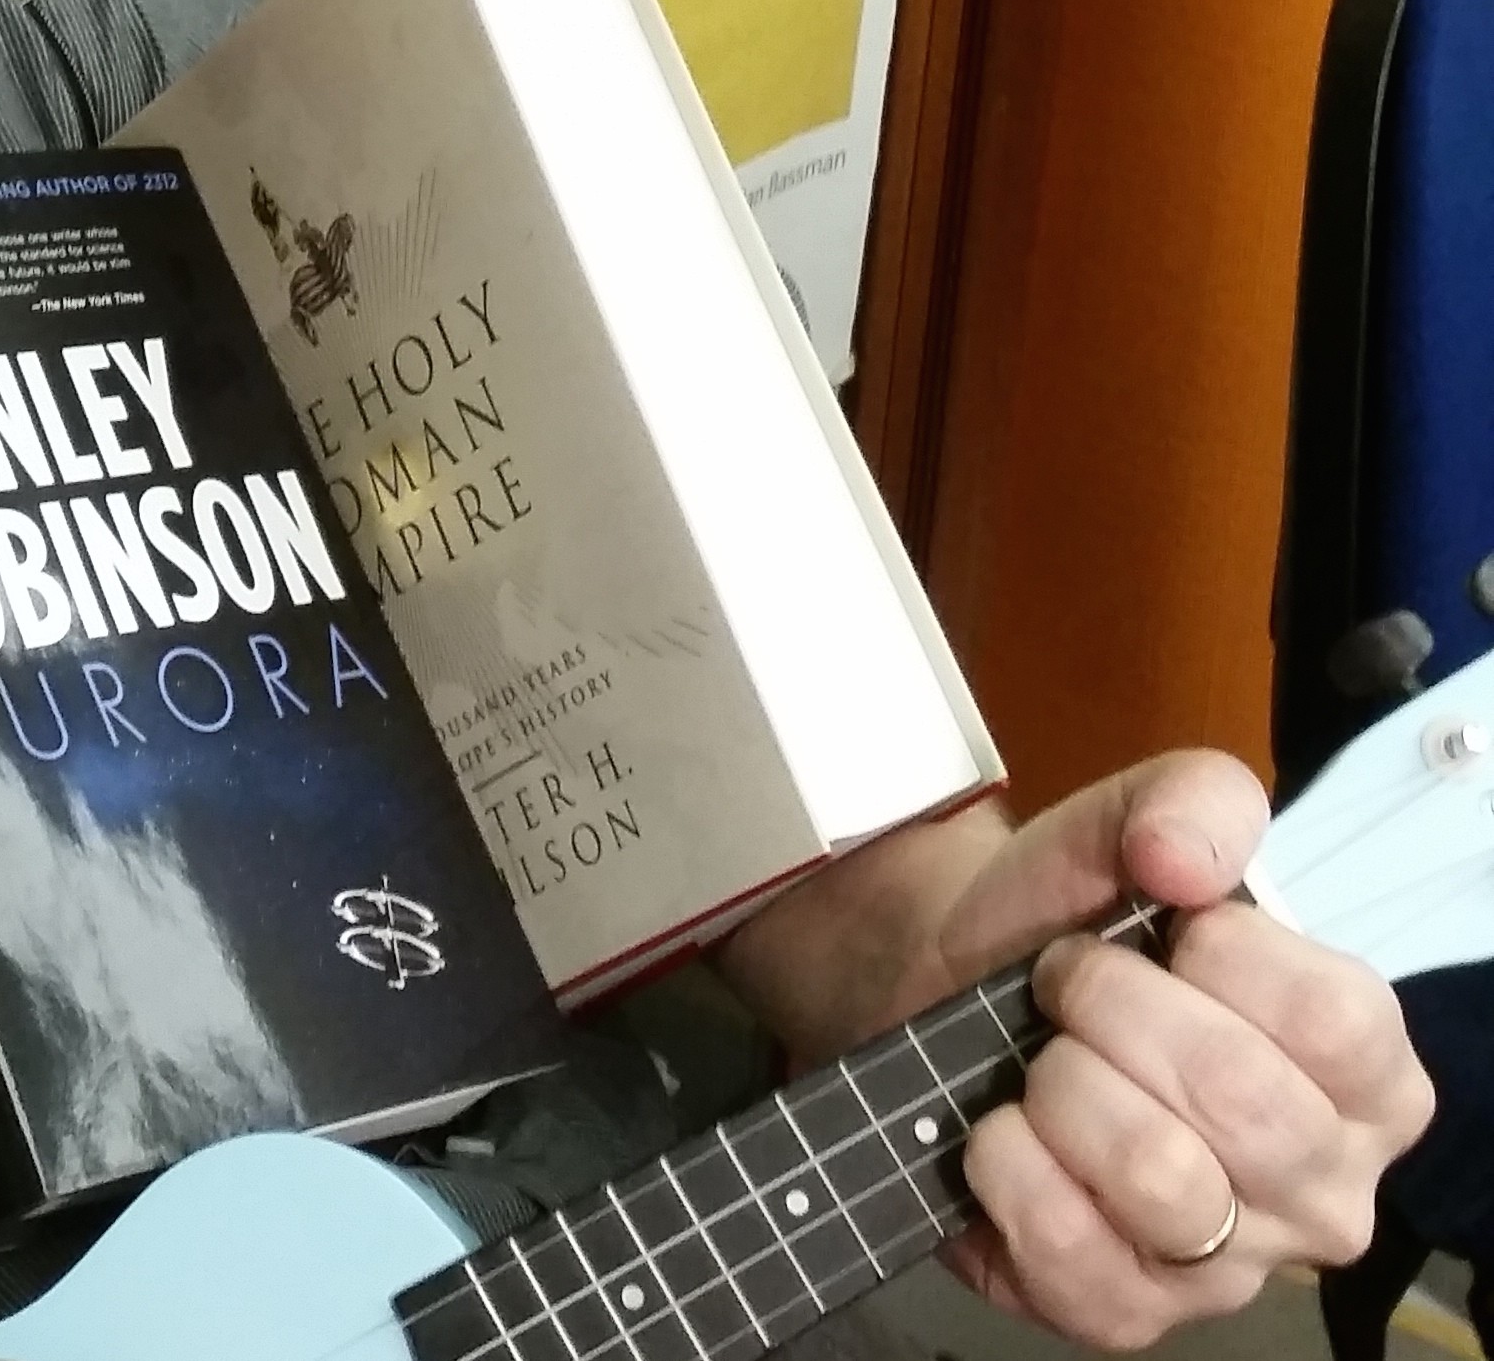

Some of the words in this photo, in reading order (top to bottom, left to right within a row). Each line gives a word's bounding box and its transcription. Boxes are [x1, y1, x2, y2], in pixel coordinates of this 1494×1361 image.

[36, 173, 110, 198] AUTHOR
[113, 172, 138, 192] OF
[143, 171, 179, 191] 2312
[0, 249, 18, 263] the
[20, 245, 67, 262] standard
[67, 244, 83, 257] for
[85, 242, 125, 255] science
[27, 231, 49, 244] one
[50, 228, 81, 242] writer
[85, 226, 118, 239] whose
[58, 260, 91, 274] would
[92, 259, 107, 272] be
[109, 257, 131, 270] Kim
[63, 295, 86, 310] New
[87, 292, 113, 307] York
[113, 290, 145, 305] Times
[346, 279, 501, 432] HOLY
[328, 376, 505, 538] OMAN
[522, 642, 587, 691] YEARS
[517, 669, 612, 738] HISTORY
[484, 772, 576, 845] TER
[586, 741, 633, 791] H.
[500, 798, 641, 896] LSON
